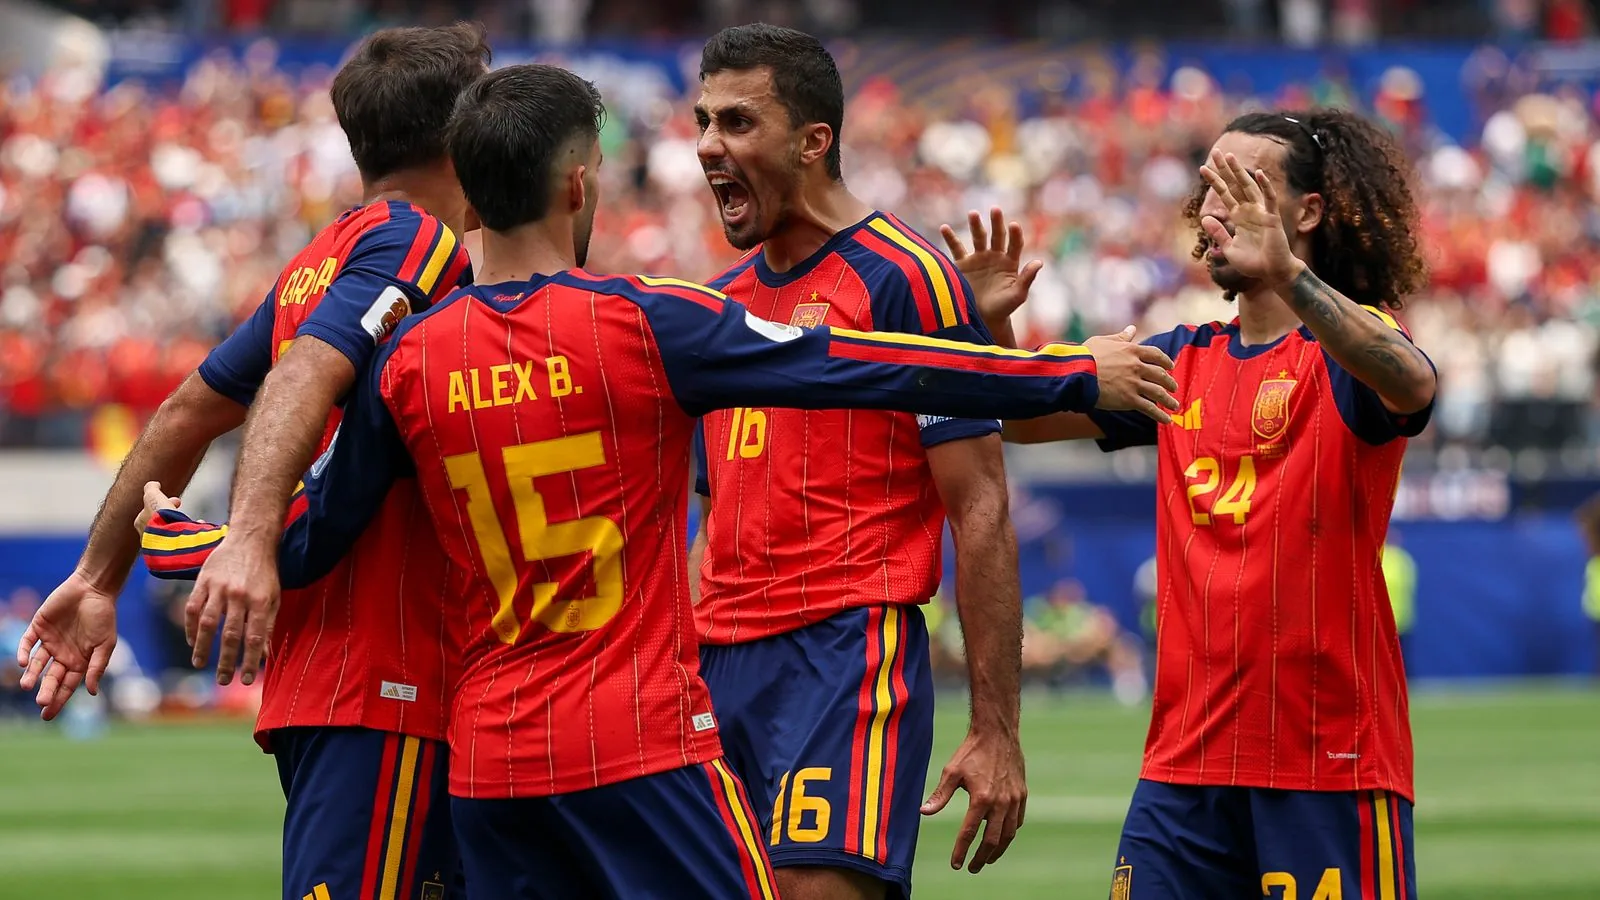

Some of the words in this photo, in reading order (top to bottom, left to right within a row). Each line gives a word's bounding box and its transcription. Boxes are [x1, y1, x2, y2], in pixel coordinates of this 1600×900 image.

[448, 360, 538, 413] ALEX
[545, 355, 583, 398] B.
[726, 407, 767, 461] 16
[1184, 455, 1257, 525] 24
[443, 430, 625, 647] 15
[770, 767, 832, 846] 16
